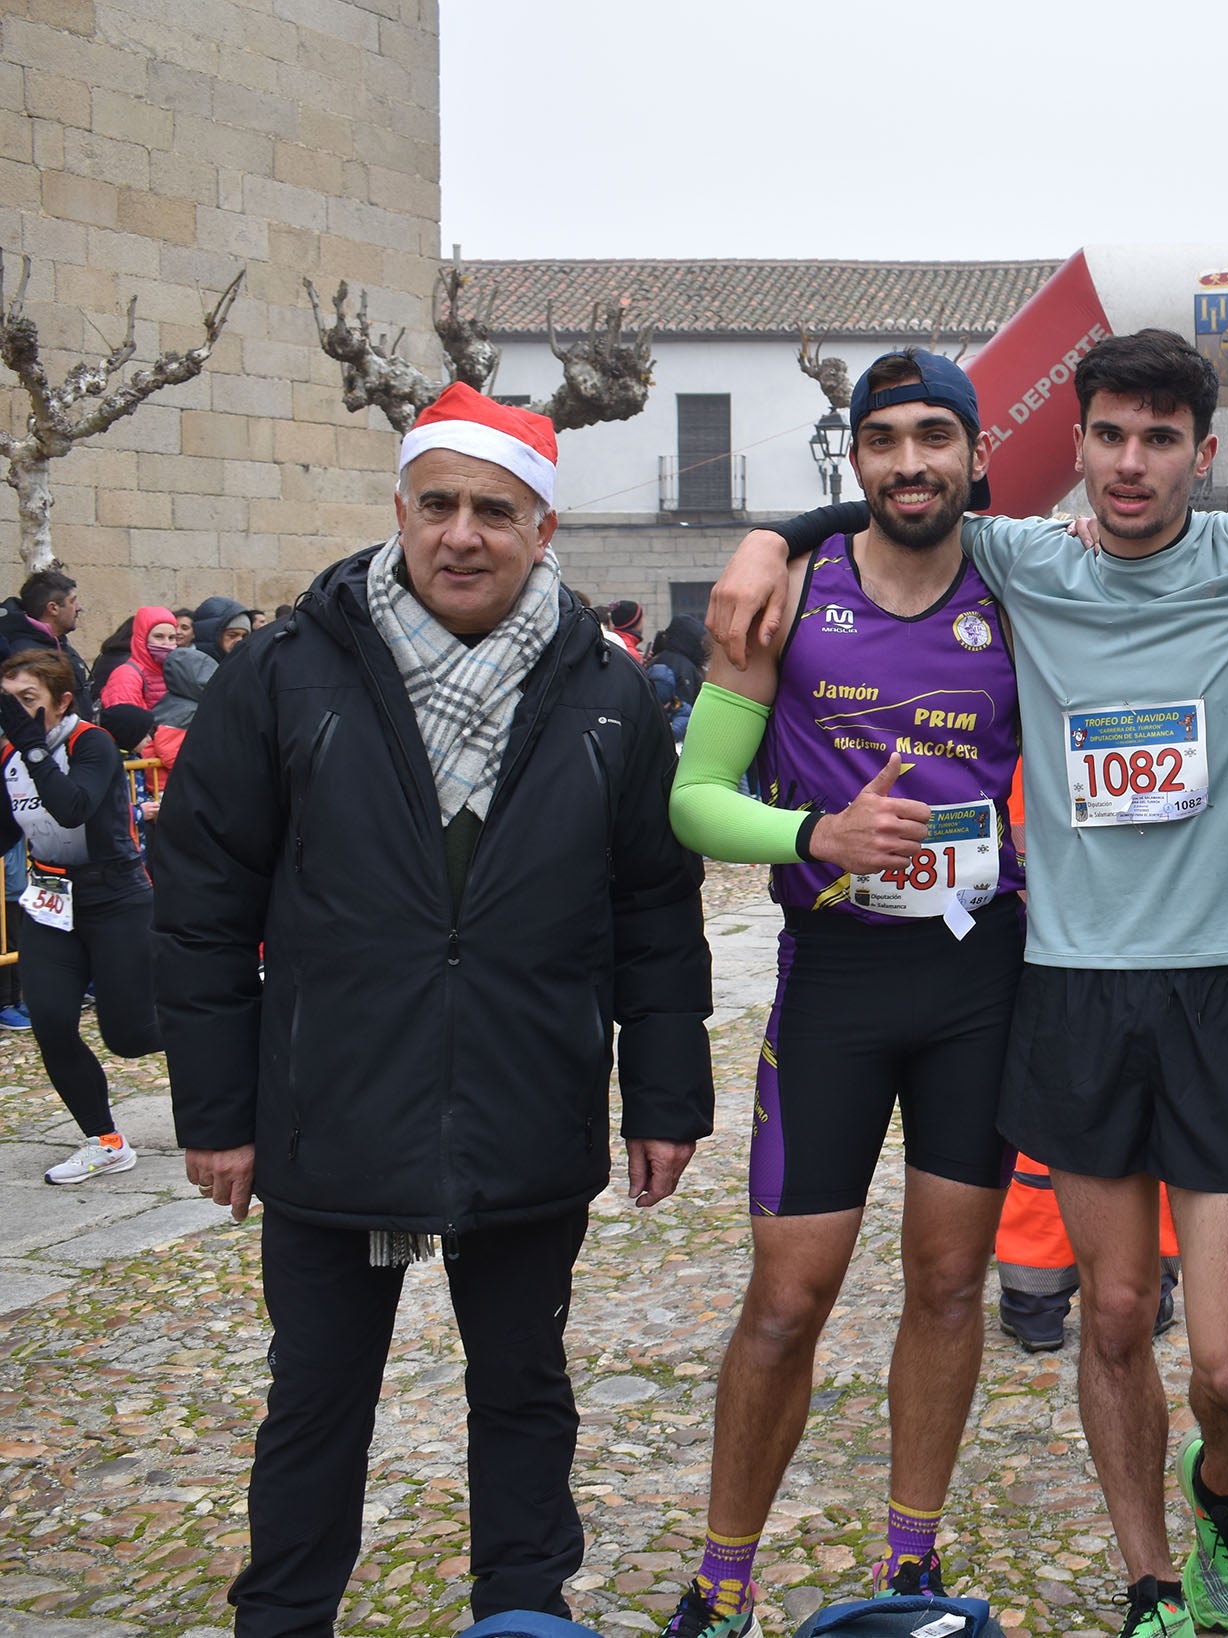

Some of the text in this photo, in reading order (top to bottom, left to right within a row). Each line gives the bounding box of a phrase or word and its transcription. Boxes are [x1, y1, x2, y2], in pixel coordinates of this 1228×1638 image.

[1008, 322, 1112, 425] DEPORTE
[812, 681, 879, 701] Jamón
[914, 708, 977, 732] PRIM
[1085, 712, 1180, 728] TROFEO DE NAVIDAD
[1134, 730, 1174, 739] SALAMANCA
[833, 737, 978, 760] Atletismo Macotera
[1083, 747, 1186, 798] 1082
[1087, 801, 1113, 809] Diputación
[1174, 797, 1203, 811] 1082
[937, 810, 976, 821] NAVIDAD
[934, 827, 970, 837] SALAMANCA
[880, 846, 956, 891] 481
[32, 889, 65, 914] 540
[871, 893, 902, 901] Diputación
[877, 902, 907, 910] Salamanca
